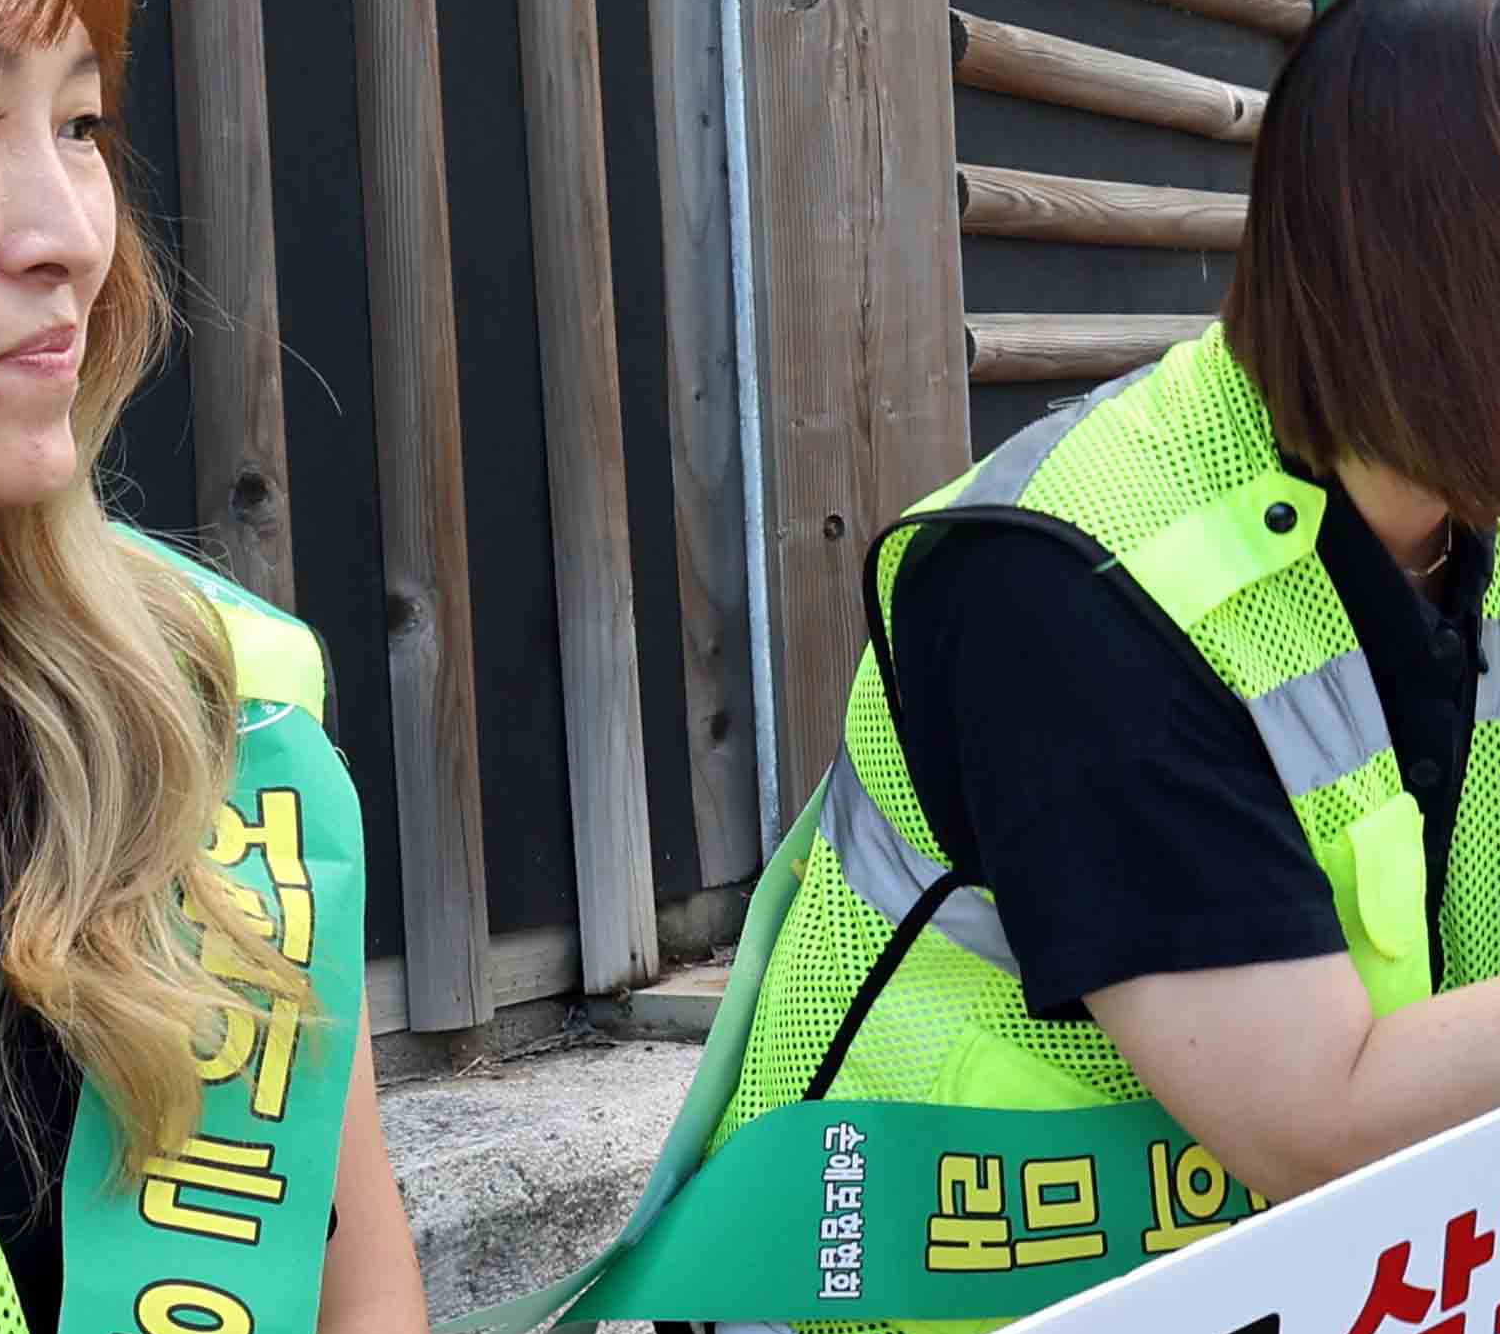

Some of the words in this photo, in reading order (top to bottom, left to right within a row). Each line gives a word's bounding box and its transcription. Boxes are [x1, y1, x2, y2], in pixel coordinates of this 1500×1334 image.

[819, 1121, 866, 1300] 손해보험협회
[925, 1151, 1107, 1273] 미래
[1142, 1140, 1271, 1255] 의
